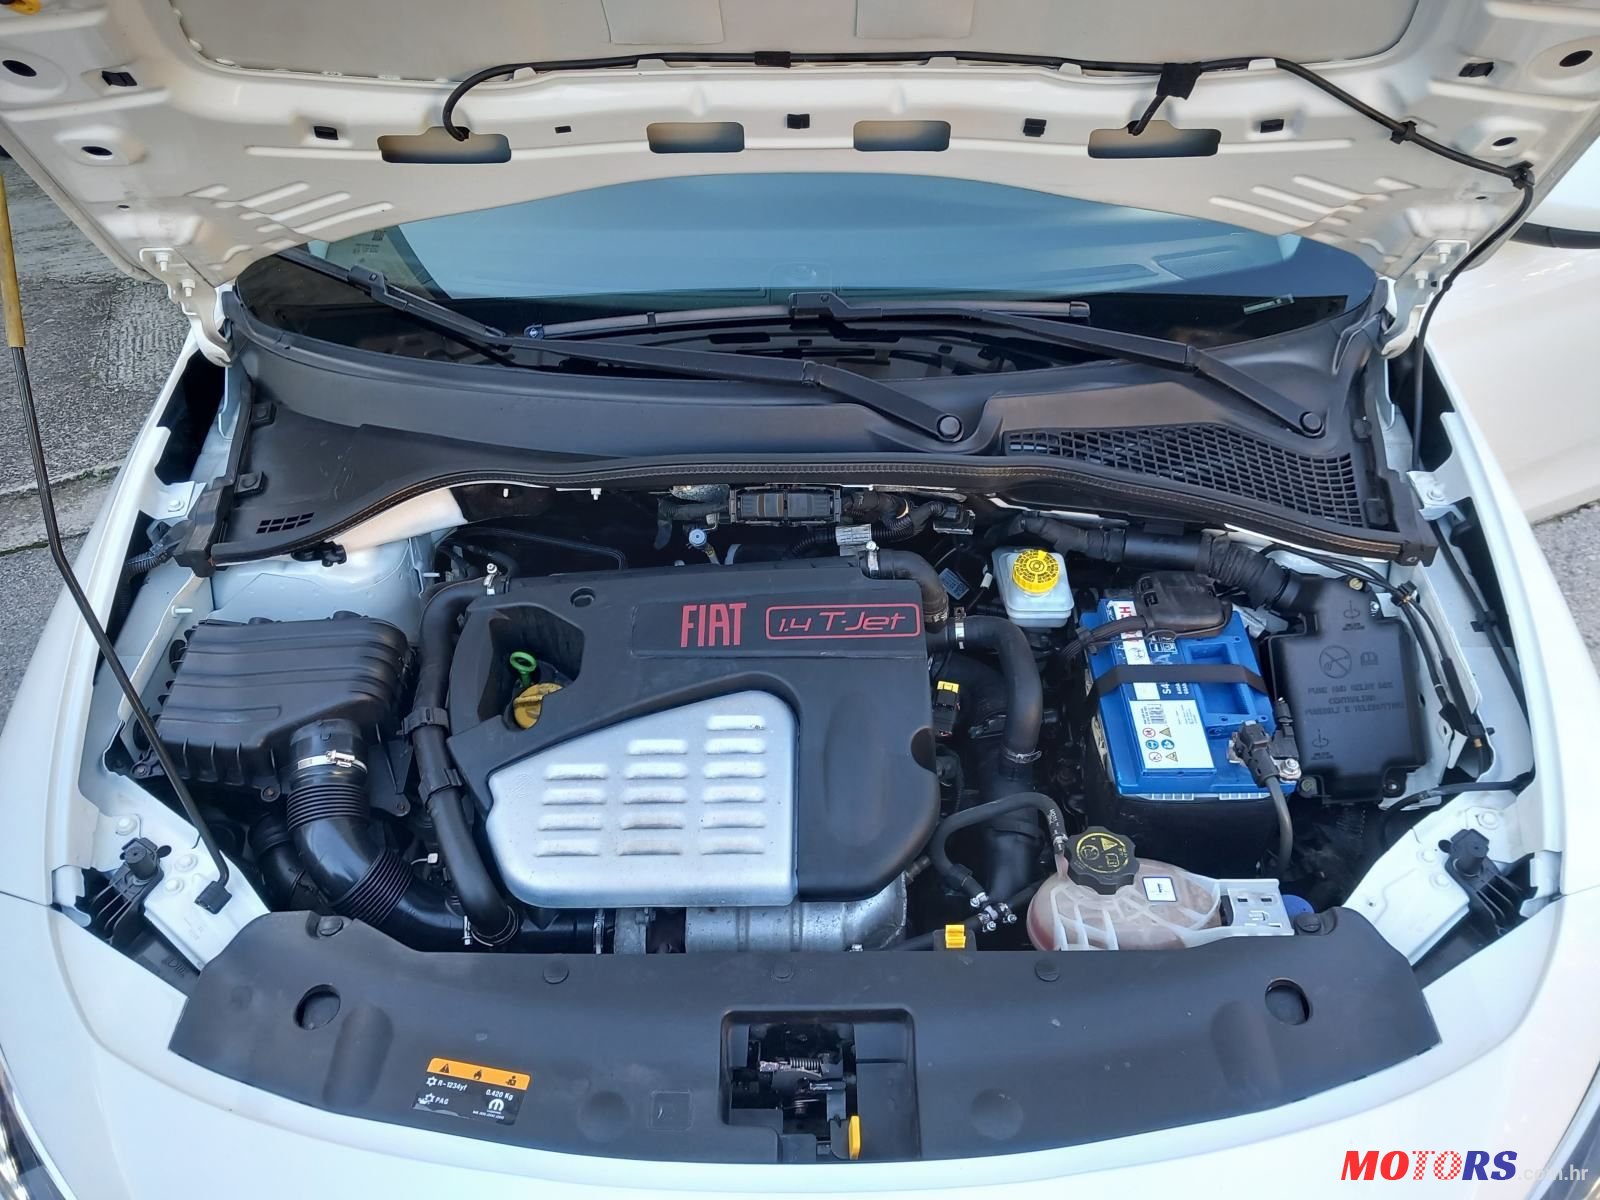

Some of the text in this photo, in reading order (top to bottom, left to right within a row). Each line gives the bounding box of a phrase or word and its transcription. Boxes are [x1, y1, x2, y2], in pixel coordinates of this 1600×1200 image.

[680, 602, 747, 648] FIAT
[779, 617, 812, 632] 1.4
[437, 1080, 468, 1092] R-1234yf
[435, 1096, 449, 1105] PAG
[486, 1089, 514, 1101] 0.420 Kg
